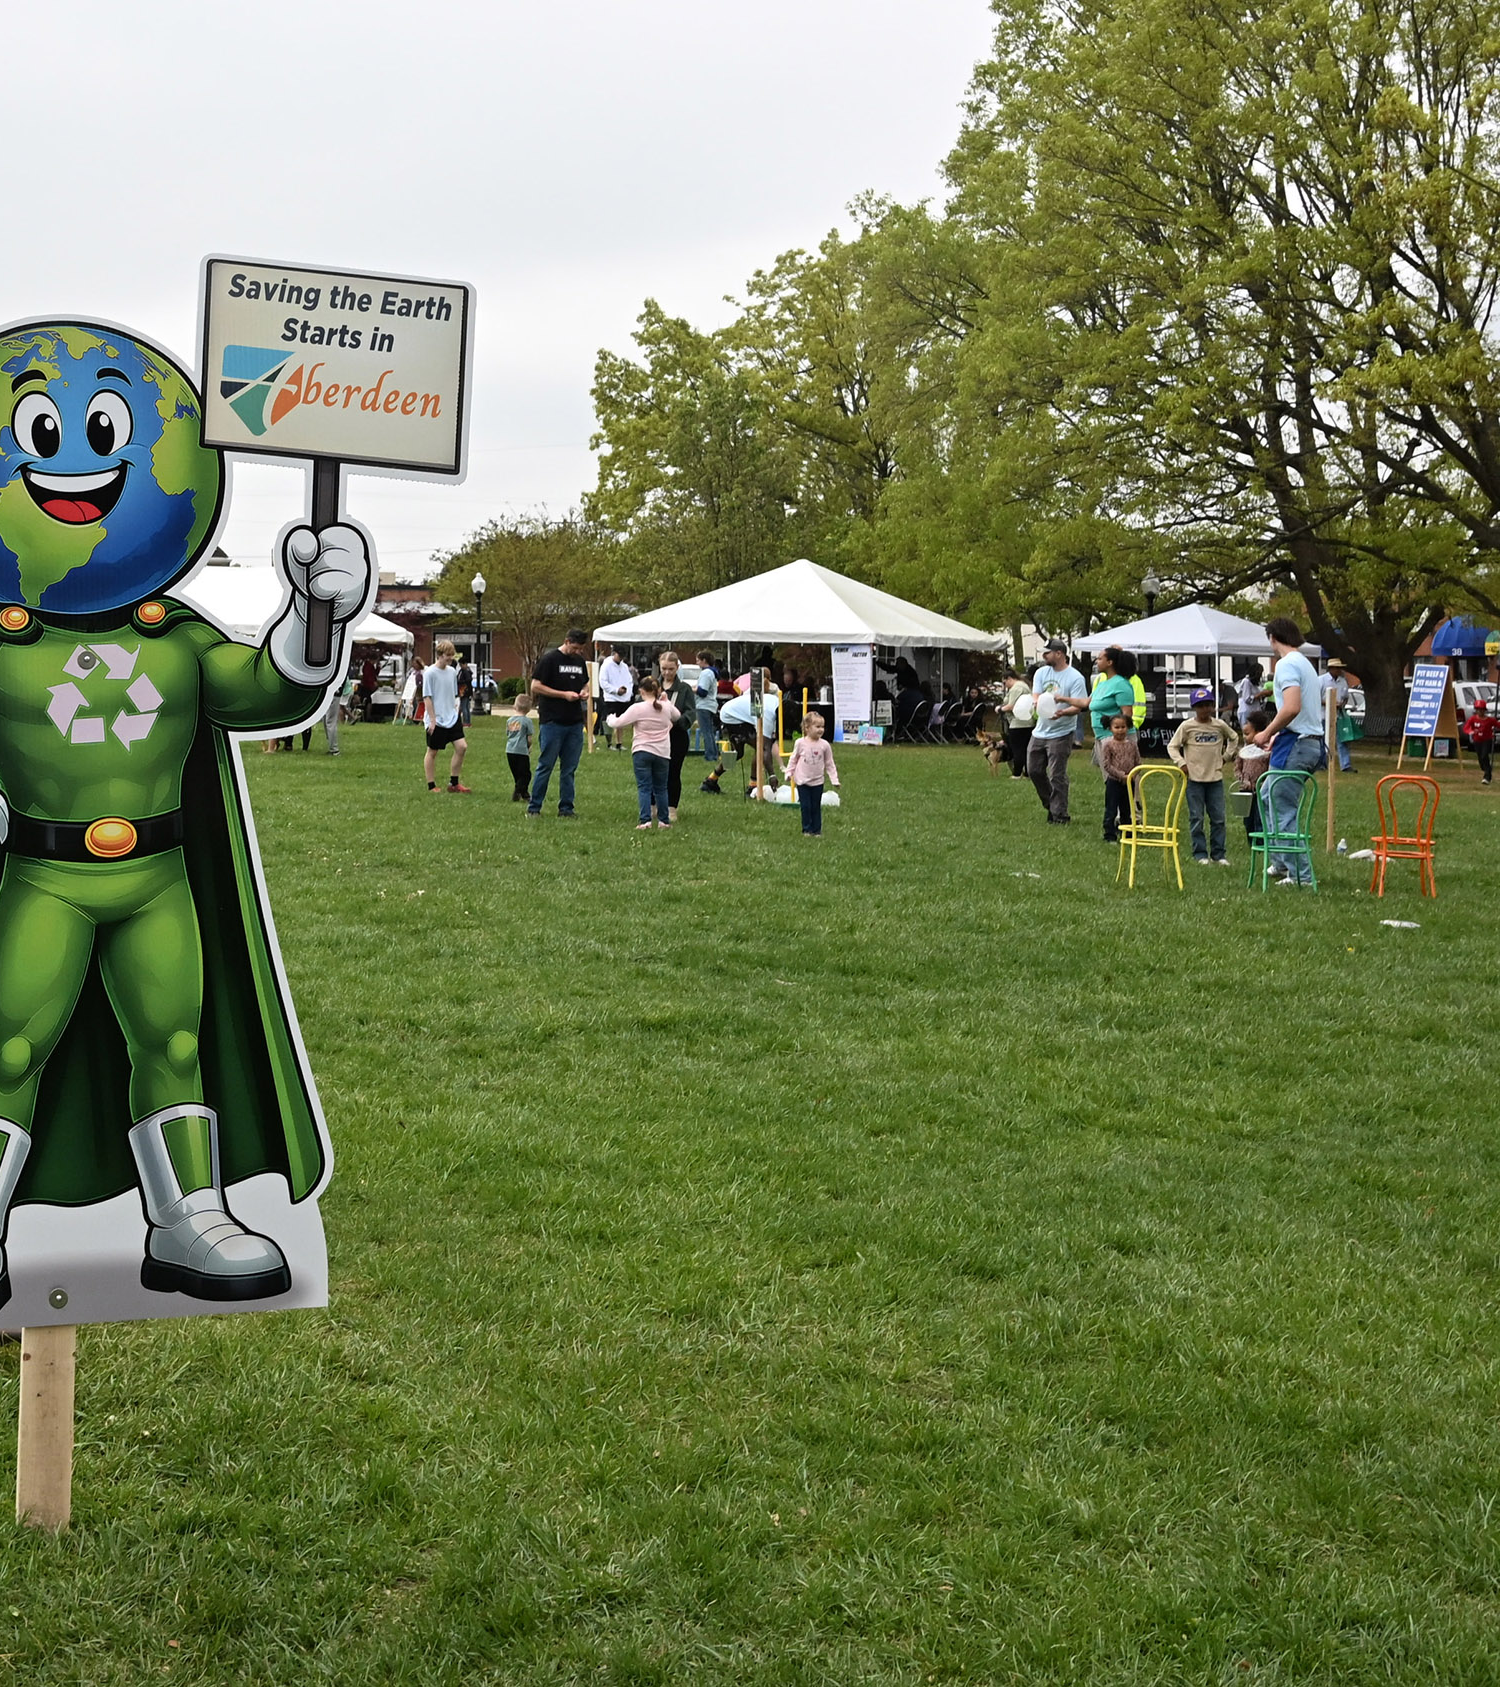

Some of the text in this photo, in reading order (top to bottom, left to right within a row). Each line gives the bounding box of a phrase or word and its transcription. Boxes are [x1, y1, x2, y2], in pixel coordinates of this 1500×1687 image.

[228, 274, 452, 321] Saving the Earth
[281, 318, 395, 352] Starts in
[270, 362, 442, 426] Aberdeen
[1452, 648, 1462, 656] 38
